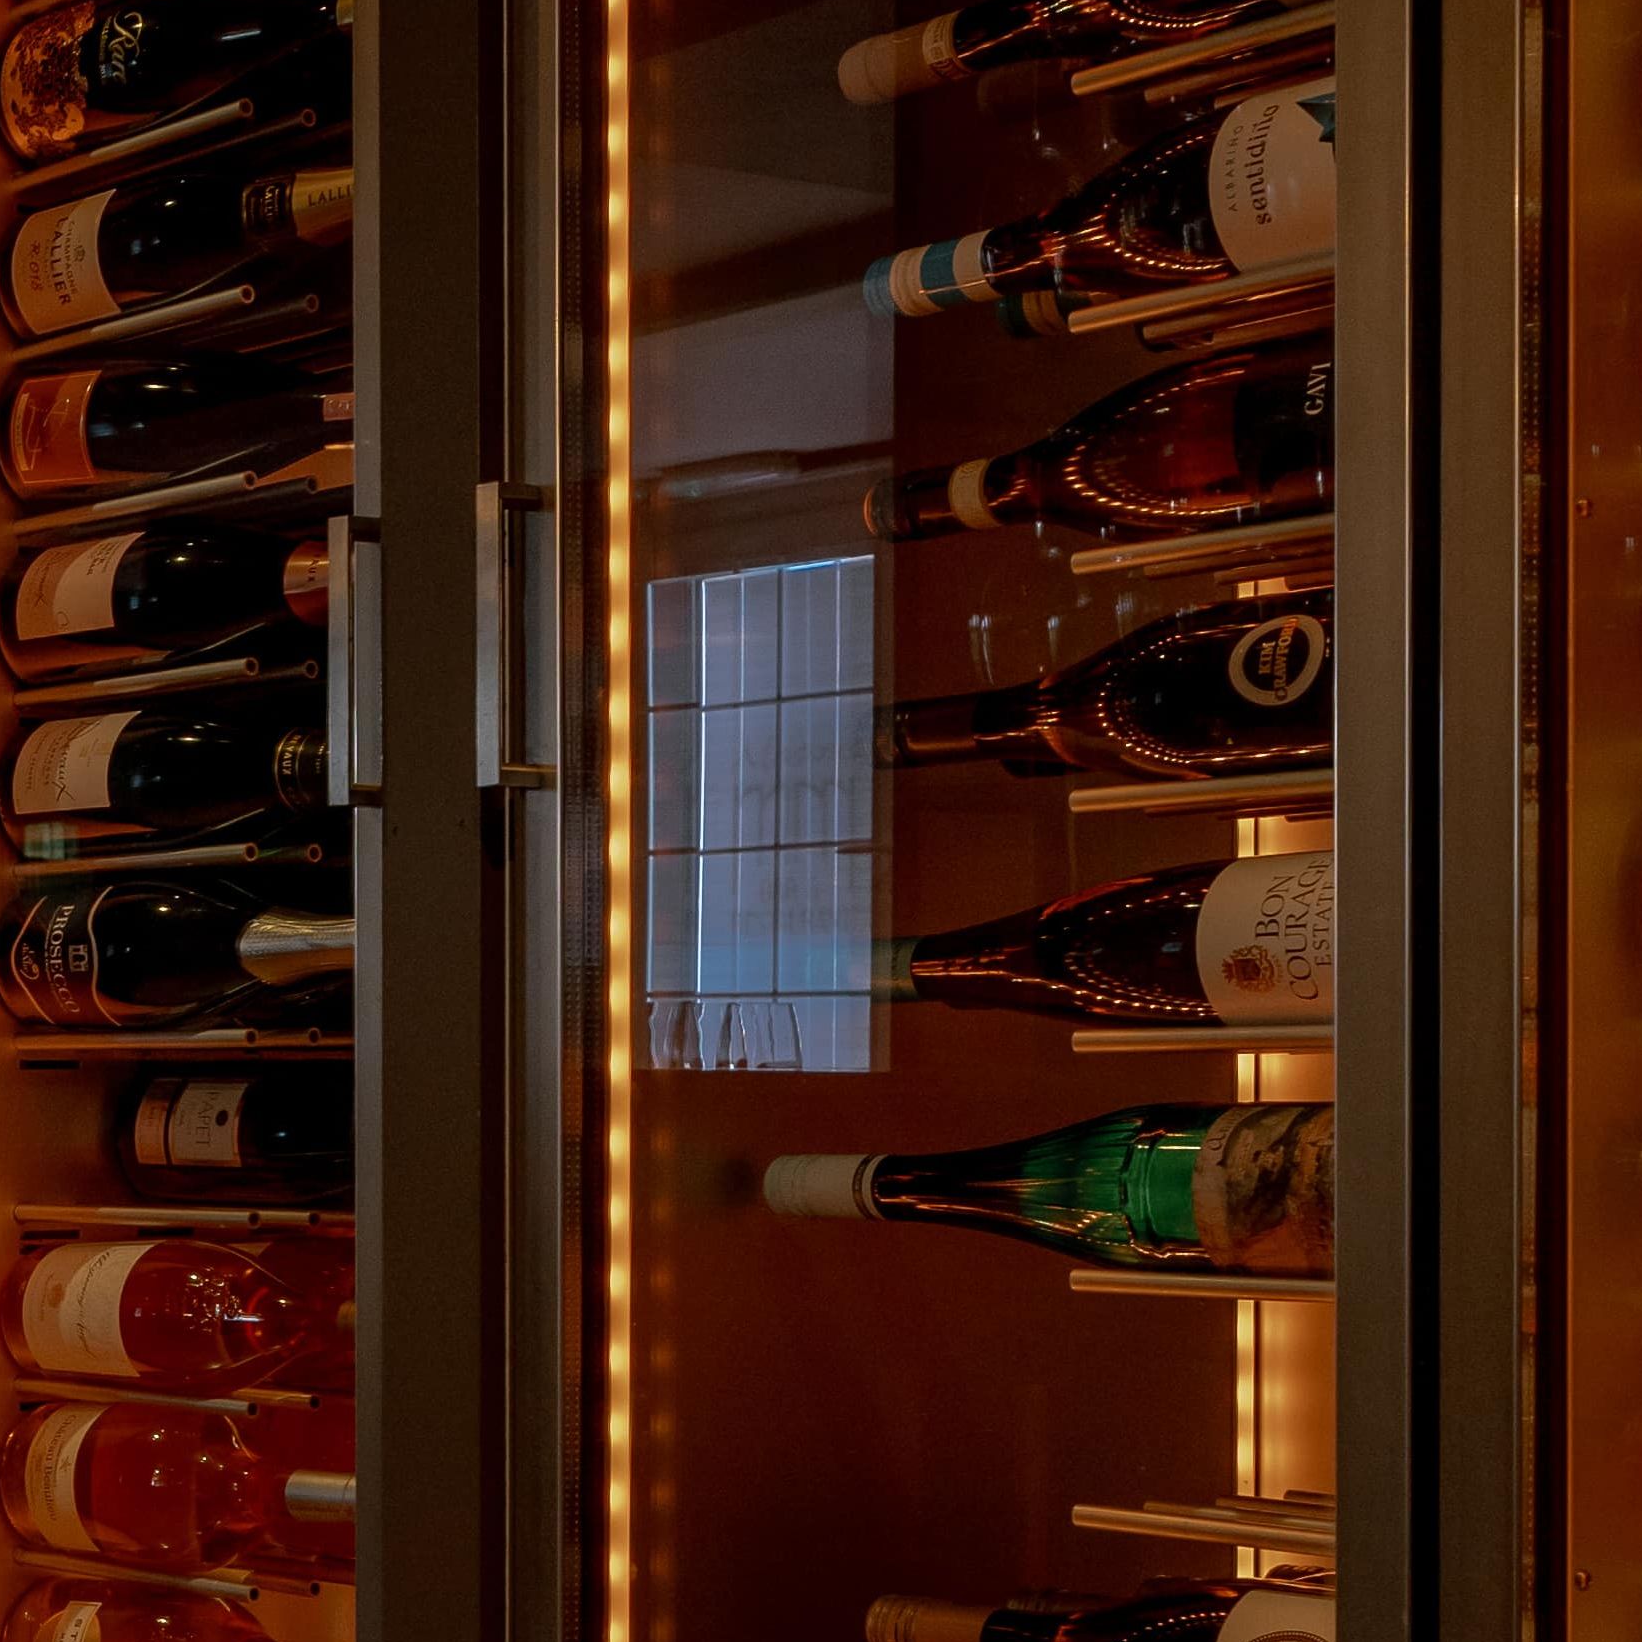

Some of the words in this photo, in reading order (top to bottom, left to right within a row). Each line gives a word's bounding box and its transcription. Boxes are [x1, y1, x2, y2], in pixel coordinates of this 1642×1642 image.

[49, 216, 72, 306] LALLIER
[1303, 360, 1332, 416] GAVI
[1257, 640, 1278, 675] KIM
[1274, 617, 1300, 701] CRAWFORD
[1255, 875, 1297, 939] BON
[47, 903, 81, 1013] PROSECCO
